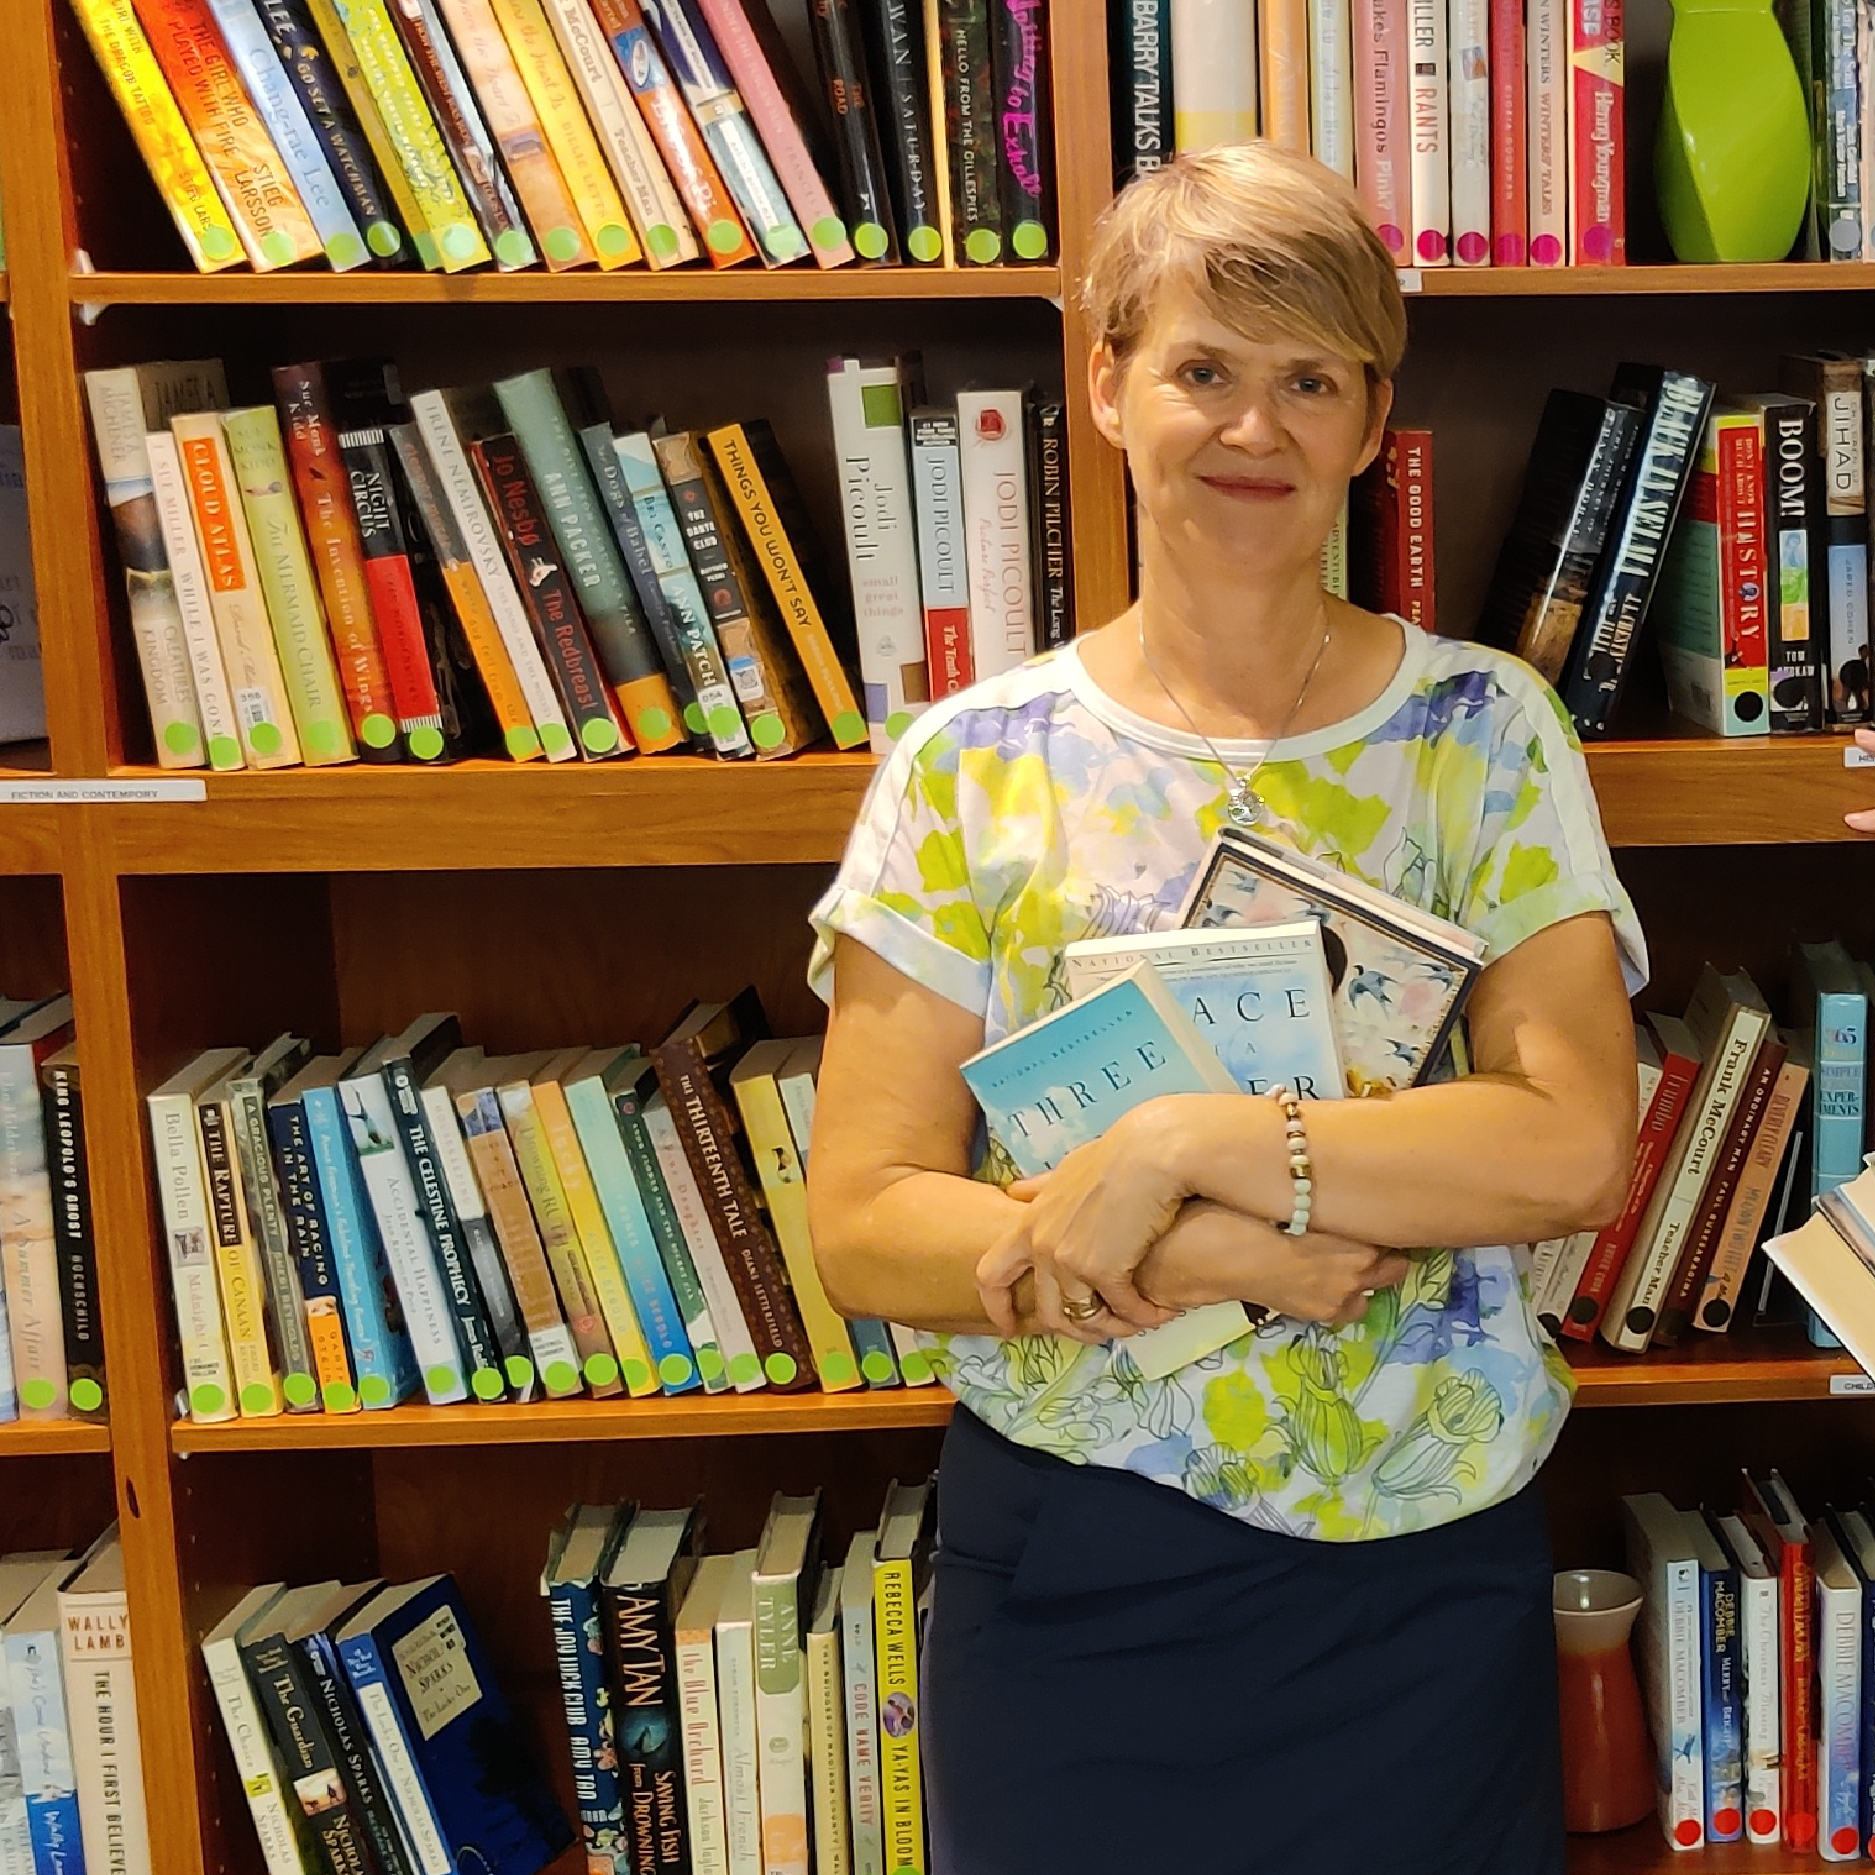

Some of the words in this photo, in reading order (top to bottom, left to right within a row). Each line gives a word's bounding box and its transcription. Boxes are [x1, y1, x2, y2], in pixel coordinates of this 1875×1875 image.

[956, 28, 969, 74] HELLO
[1133, 0, 1160, 69] BARRY
[189, 22, 213, 53] THE
[203, 51, 229, 90] GIRL
[221, 90, 246, 128] WHO
[959, 78, 971, 118] FROM
[961, 121, 974, 146] THE
[1134, 75, 1161, 149] TALKS
[1595, 90, 1613, 141] Henny
[295, 60, 316, 86] GO
[306, 84, 331, 117] SET
[321, 115, 337, 131] A
[330, 133, 379, 217] WATCHMAN
[962, 148, 978, 223] GILLESPIES
[1596, 143, 1613, 223] Youngman
[1648, 382, 1701, 462] BLACK
[1833, 396, 1851, 490] JIHAD
[491, 448, 519, 478] Jo
[927, 456, 949, 504] JODI
[1044, 437, 1060, 498] ROBIN
[1406, 446, 1421, 477] THE
[1640, 462, 1679, 495] IN
[1778, 419, 1805, 516] BOOM!
[193, 442, 219, 517] CLOUD
[209, 524, 234, 588] ATLAS
[316, 491, 338, 531] The
[348, 469, 376, 538] CIRCUS
[364, 470, 392, 531] NIGHT
[501, 478, 542, 549] Nesbø
[845, 455, 878, 562] Picoult
[873, 482, 897, 530] Jodi
[1408, 484, 1422, 528] GOOD
[721, 438, 758, 501] THINGS
[748, 501, 773, 538] YOU
[763, 537, 798, 596] WON'T
[787, 595, 812, 630] SAY
[934, 508, 954, 594] PICOULT
[1046, 501, 1064, 591] PILCHER
[1618, 494, 1670, 580] SELMA
[325, 536, 359, 626] Invention
[1408, 534, 1423, 588] EARTH
[1735, 511, 1759, 640] HISTORY
[540, 588, 569, 623] The
[346, 630, 366, 653] of
[550, 622, 602, 712] Redbreast
[349, 655, 379, 715] Wings
[10, 791, 53, 799] FICTION
[82, 790, 158, 798] CONTEMPORY
[1190, 938, 1314, 957] BESTSELLER
[1192, 988, 1312, 1026] ACE
[54, 1069, 70, 1106] KING
[1007, 1040, 1168, 1141] THREE
[1715, 1037, 1749, 1096] Frank
[57, 1111, 77, 1188] LEOPOLD'S
[164, 1112, 184, 1158] Bella
[408, 1125, 428, 1155] THE
[1685, 1098, 1727, 1178] McCourt
[65, 1194, 81, 1239] GHOST
[171, 1164, 191, 1219] Pollen
[416, 1156, 448, 1231] CELESTINE
[437, 1231, 470, 1308] PROPHECY
[67, 1615, 128, 1632] WALLY
[550, 1597, 573, 1624] THE
[616, 1593, 662, 1654] AMY
[883, 1572, 903, 1637] REBECCA
[74, 1634, 126, 1651] LAMB
[554, 1625, 577, 1655] JOY
[886, 1642, 904, 1685] WELLS
[94, 1671, 111, 1699] THE
[558, 1655, 583, 1690] LUCK
[621, 1653, 665, 1706] TAN
[97, 1704, 115, 1746] HOUR
[271, 1673, 297, 1707] The
[284, 1704, 314, 1771] Guardian
[563, 1691, 587, 1726] CLUB
[569, 1735, 593, 1769] AMY
[892, 1745, 909, 1792] YA-YAS
[102, 1763, 120, 1808] FIRST
[574, 1772, 597, 1801] TAN
[894, 1799, 910, 1812] IN
[895, 1820, 913, 1867] BLOOM
